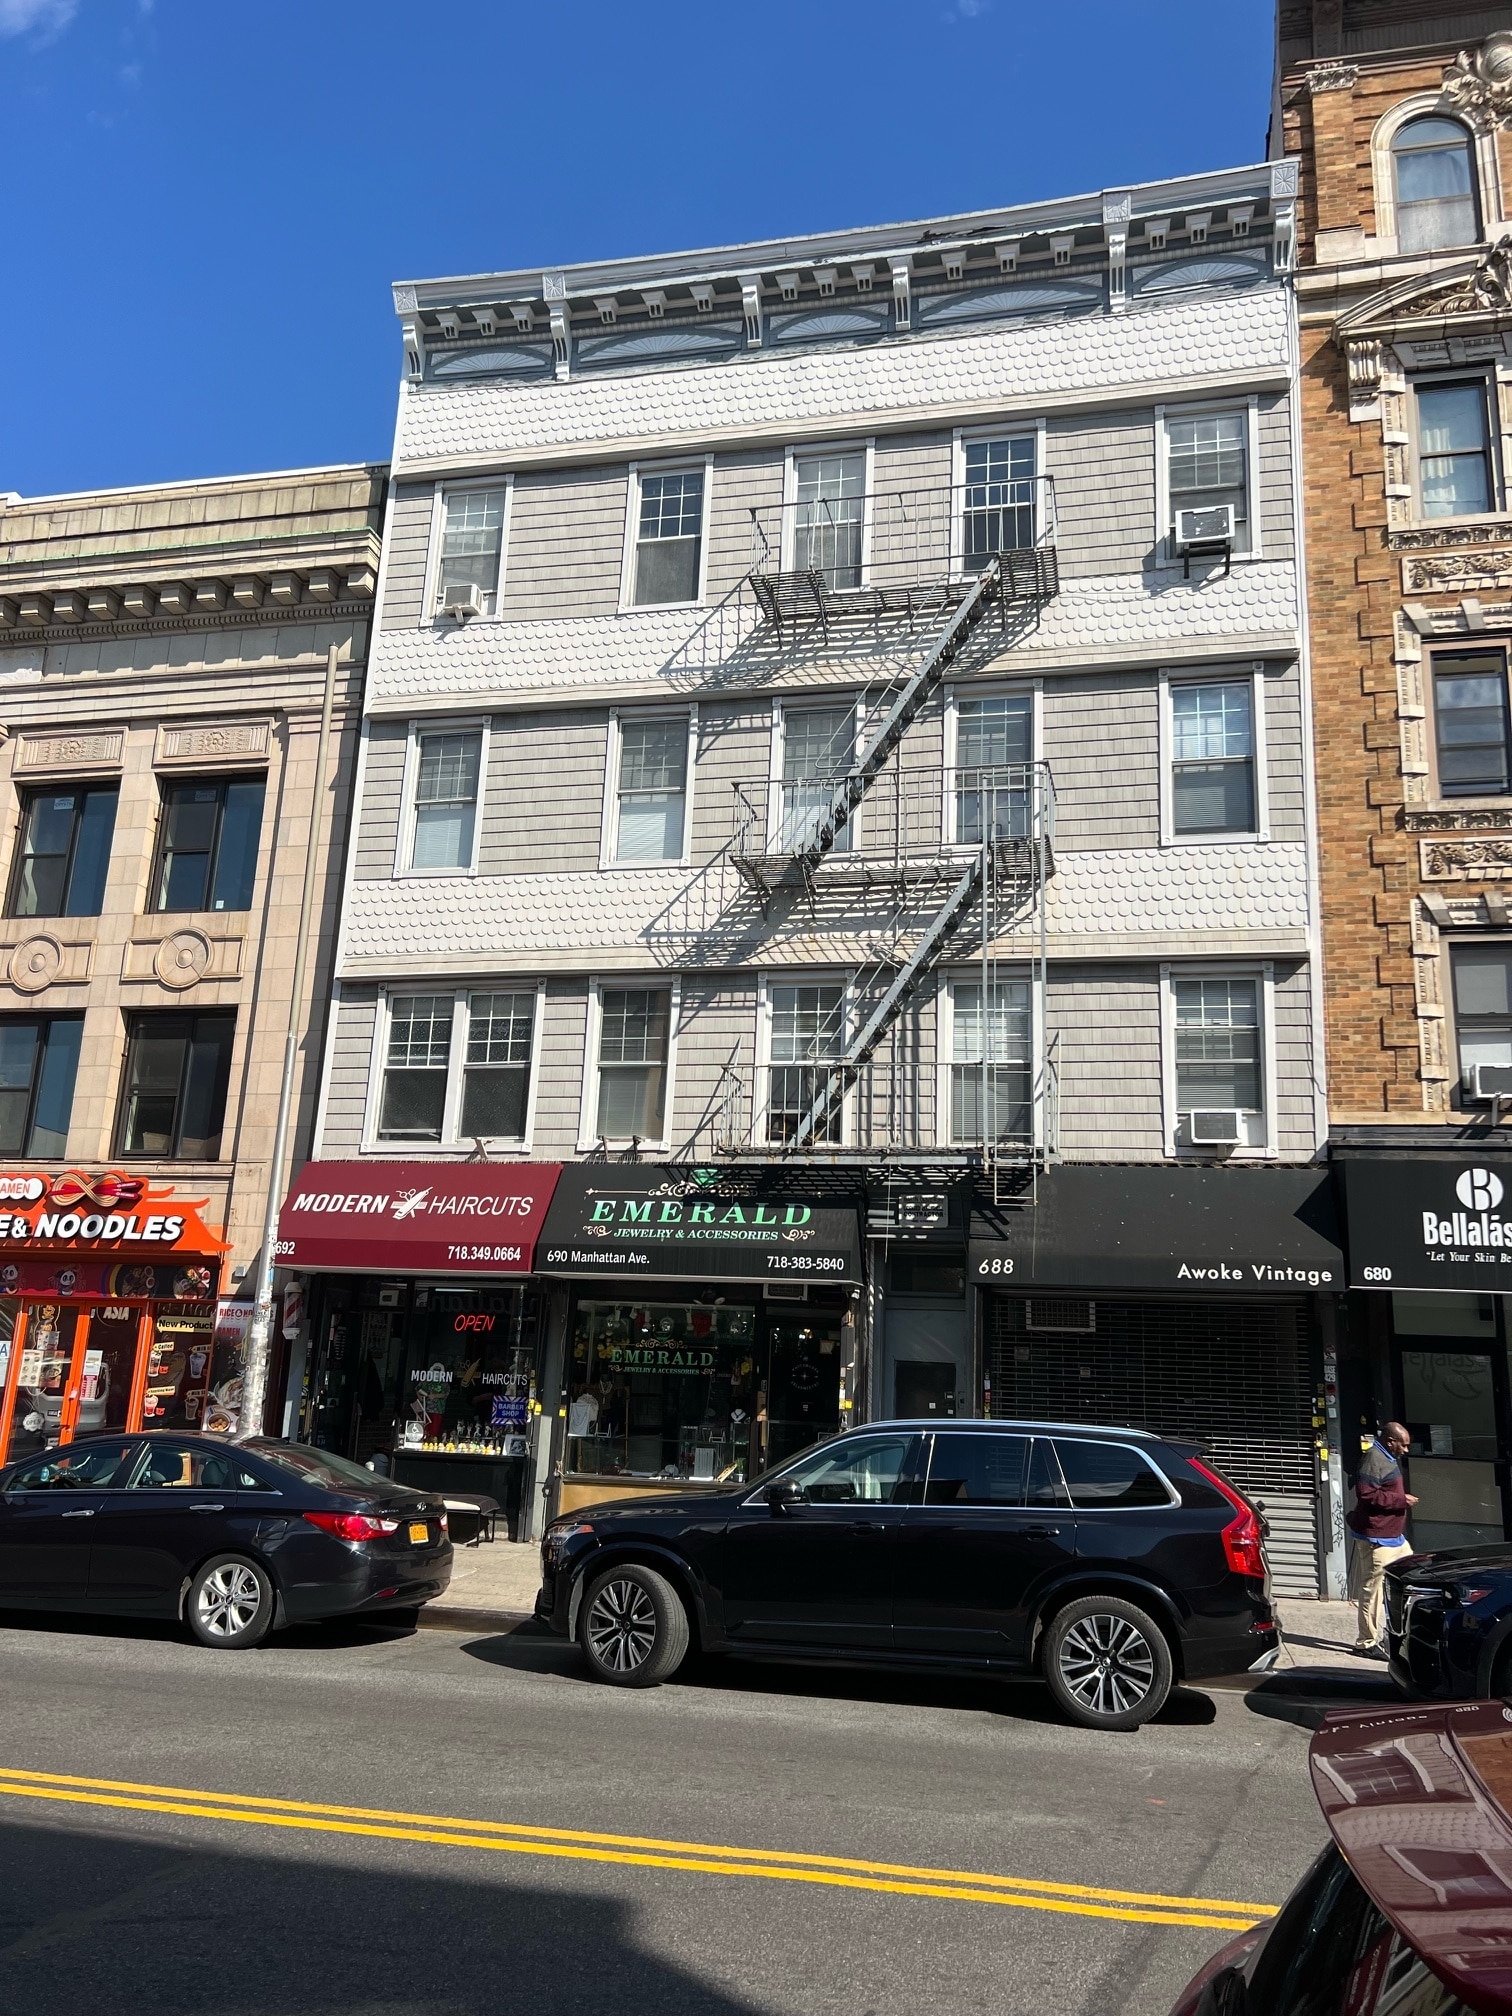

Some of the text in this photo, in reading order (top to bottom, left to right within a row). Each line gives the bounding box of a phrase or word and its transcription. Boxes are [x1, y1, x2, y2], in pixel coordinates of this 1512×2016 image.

[292, 1193, 534, 1216] MODERN HAIRCUTS
[589, 1200, 811, 1225] EMERALD
[34, 1213, 183, 1241] NOODLES
[613, 1228, 779, 1241] JEWELRY & ACCESSORIES
[275, 1241, 295, 1255] 692
[447, 1245, 521, 1261] 718.349.0664
[546, 1250, 650, 1264] 690 Manhattan Ave.
[766, 1255, 845, 1270] 718-383-5840
[1449, 1251, 1471, 1262] Your
[1474, 1252, 1496, 1263] Skin
[978, 1258, 1014, 1275] 688
[1363, 1266, 1392, 1281] 680
[1177, 1263, 1333, 1286] Awoke Vintage
[219, 1308, 235, 1317] RICE
[158, 1320, 214, 1330] New Product
[453, 1314, 496, 1332] OPEN
[0, 1343, 8, 1357] A
[609, 1349, 714, 1366] EMERALD
[410, 1370, 528, 1386] MODERN HAIRCUTS
[497, 1403, 525, 1411] BARBER
